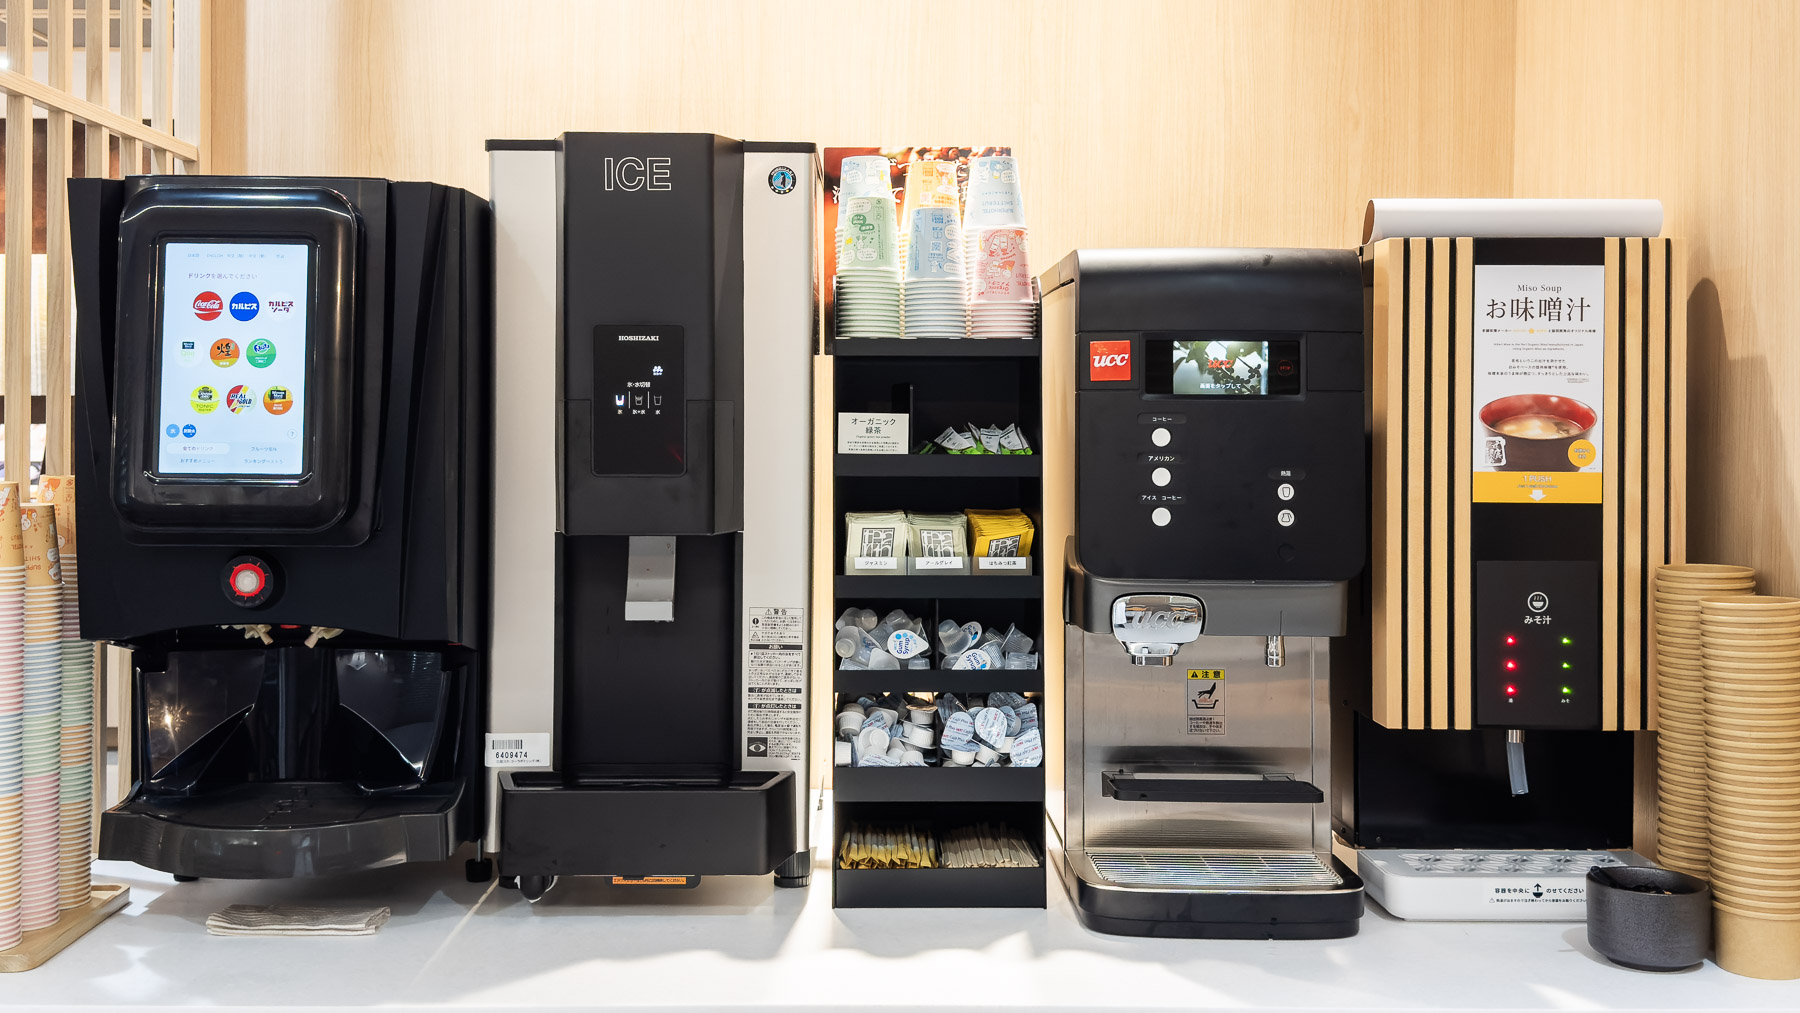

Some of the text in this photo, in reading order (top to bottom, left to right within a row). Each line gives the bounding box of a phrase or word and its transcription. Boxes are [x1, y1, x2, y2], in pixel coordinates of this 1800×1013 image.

[604, 156, 672, 191] ICE
[1540, 284, 1562, 293] Soup
[194, 300, 221, 309] Coca-Cola
[1486, 296, 1592, 322] お味噌汁
[1524, 615, 1552, 625] みそ汁
[972, 652, 980, 665] Gum
